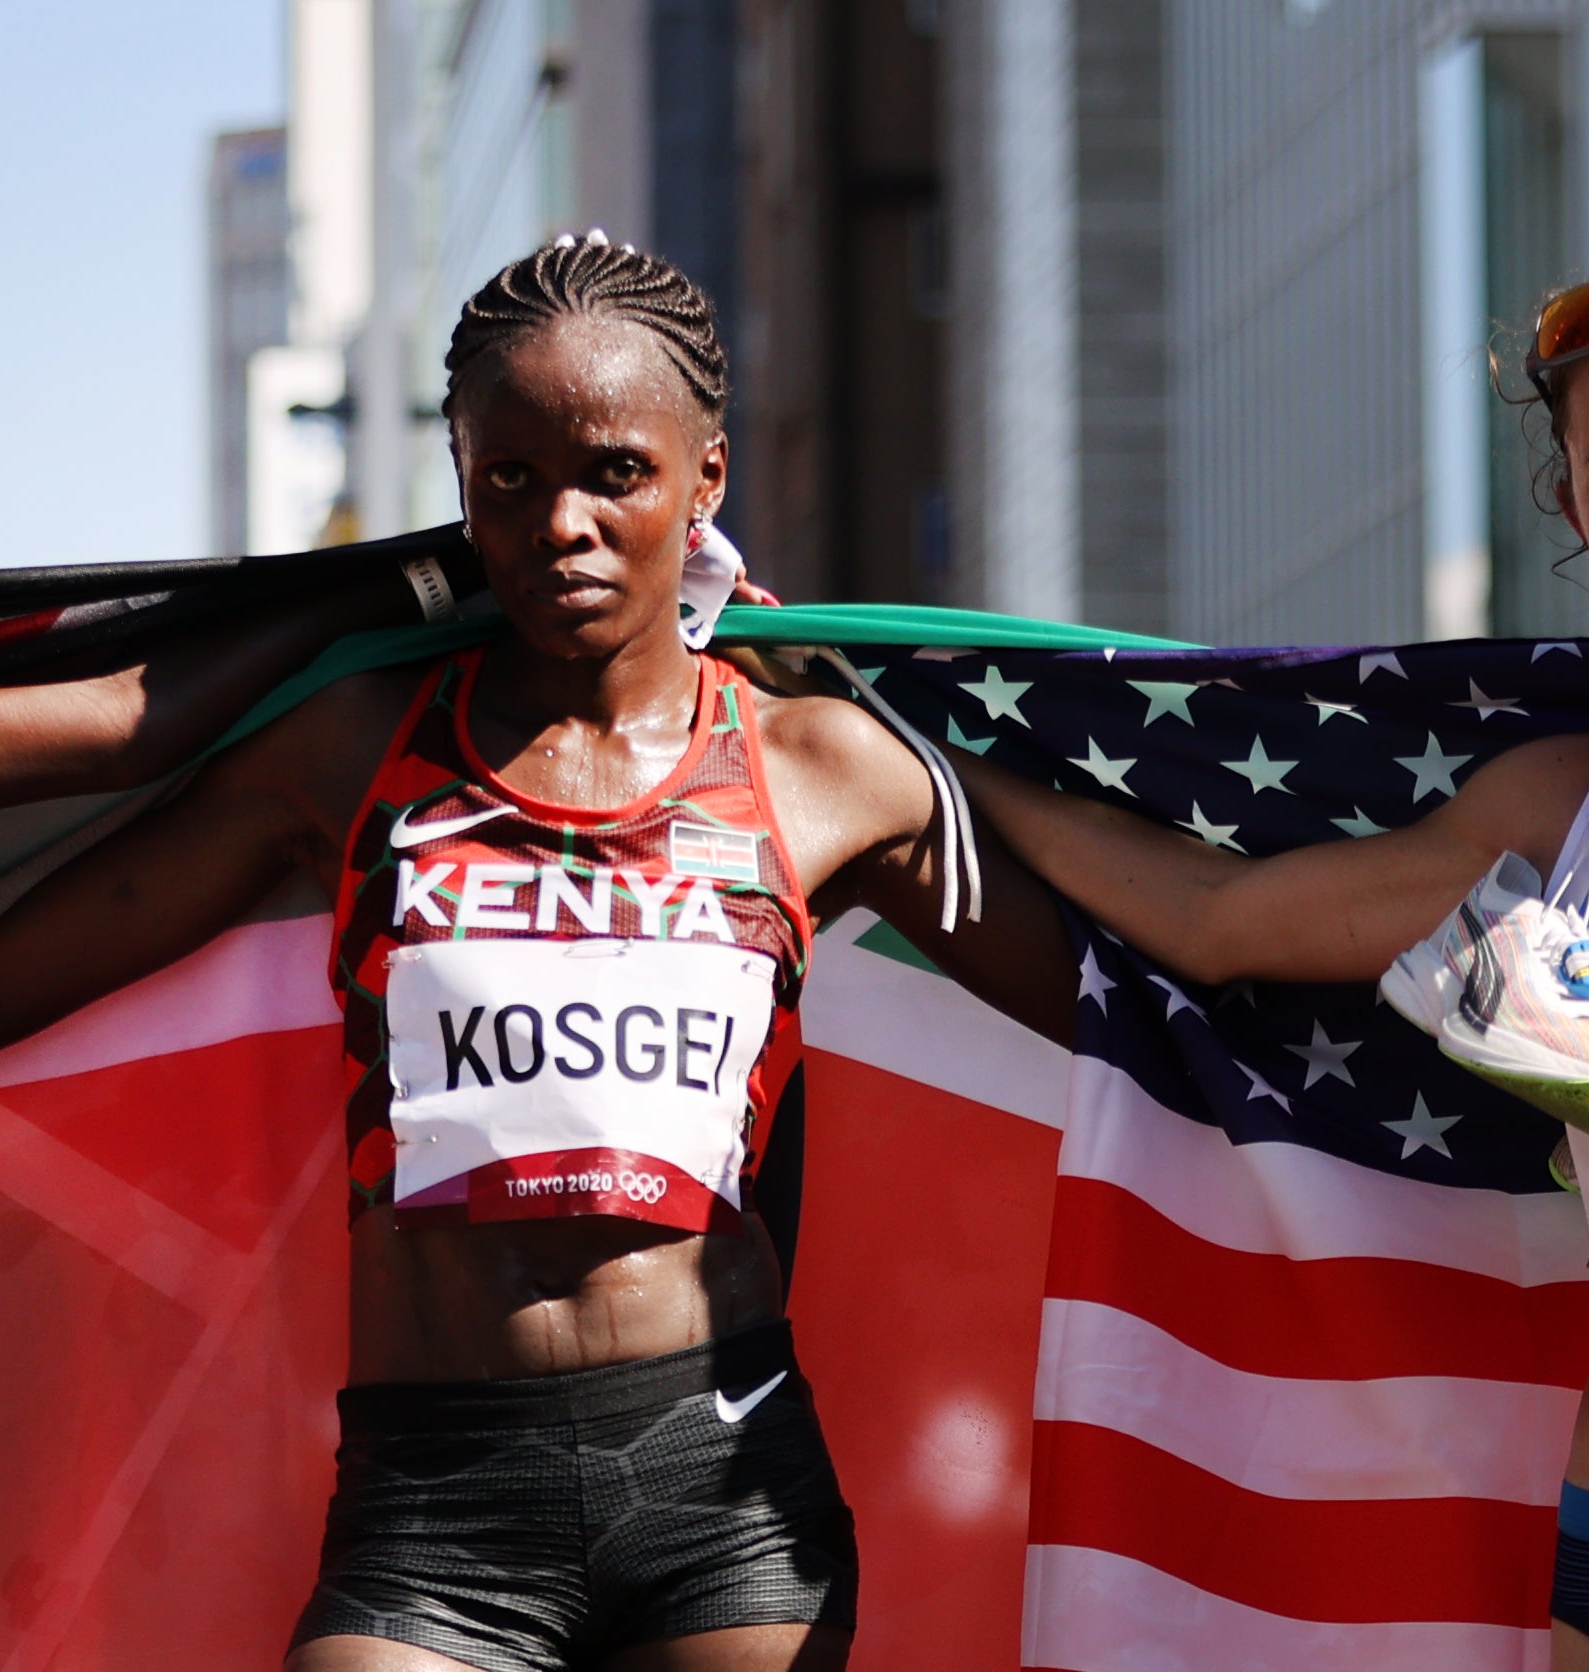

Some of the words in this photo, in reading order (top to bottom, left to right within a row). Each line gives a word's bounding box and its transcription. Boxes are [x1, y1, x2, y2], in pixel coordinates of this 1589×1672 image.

[392, 859, 738, 941] KENYA
[438, 1002, 735, 1095] KOSGEI
[505, 1176, 564, 1198] TOKYO
[567, 1172, 612, 1193] 2020
